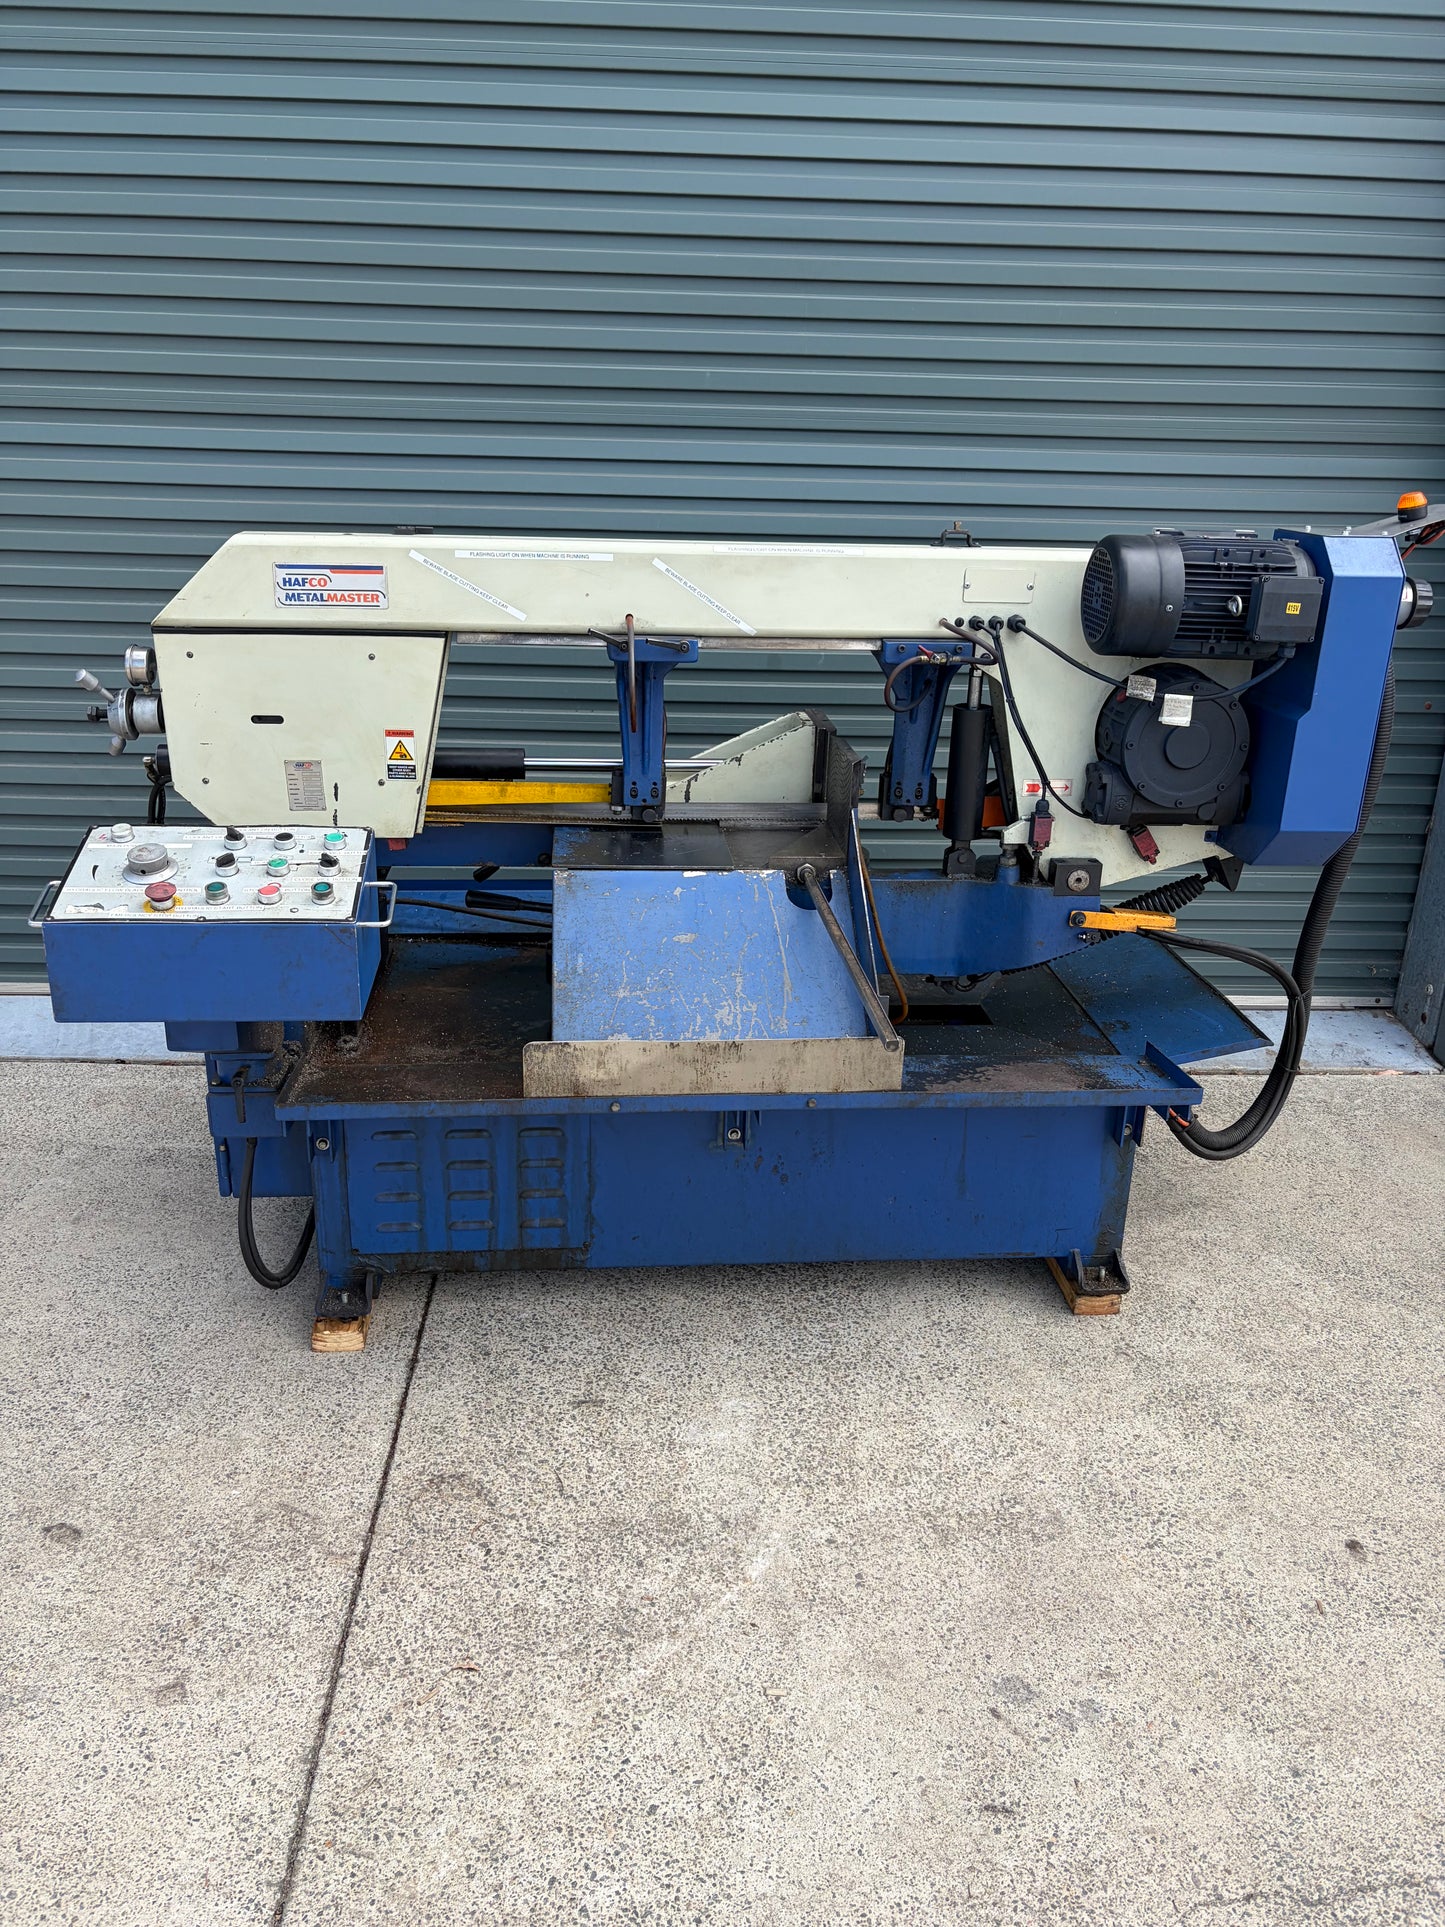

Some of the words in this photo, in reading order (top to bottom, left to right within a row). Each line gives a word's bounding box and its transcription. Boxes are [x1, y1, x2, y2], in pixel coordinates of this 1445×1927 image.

[282, 577, 328, 588] HAFCO
[423, 558, 443, 573] BEWARE
[443, 570, 459, 582] BLADE
[459, 579, 480, 594] CUTTING
[480, 591, 493, 600] KEEP
[492, 598, 509, 610] CLEAR
[285, 592, 380, 603] METALMASTER
[665, 567, 683, 583] BEWARE
[683, 580, 697, 593] BLADE
[697, 591, 716, 607] CUTTING
[715, 604, 727, 614] KEEP
[726, 612, 741, 625] CLEAR
[1287, 604, 1299, 612] 415V
